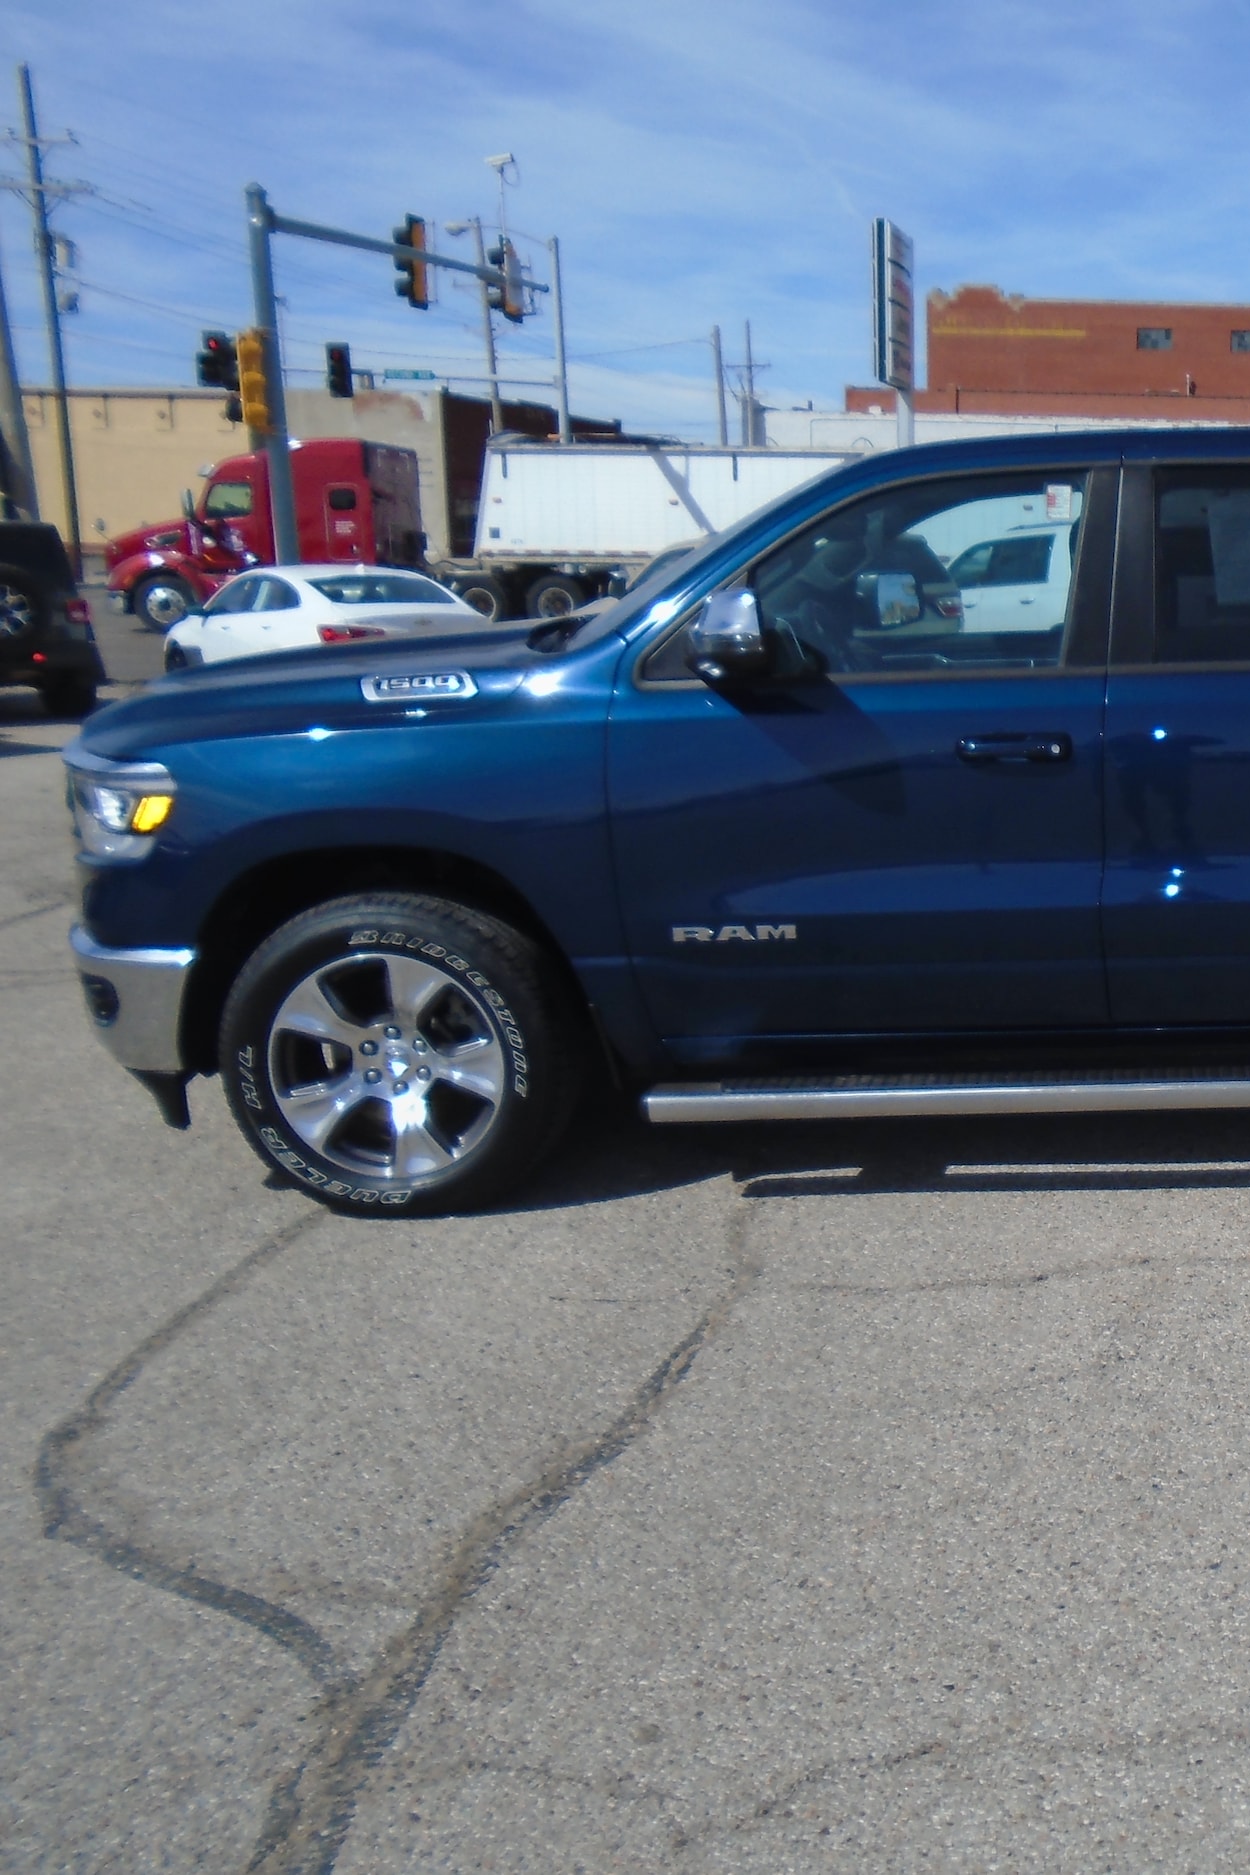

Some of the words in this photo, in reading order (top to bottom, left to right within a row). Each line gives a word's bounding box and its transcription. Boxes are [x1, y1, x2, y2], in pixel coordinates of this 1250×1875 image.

[380, 674, 460, 691] 1500
[672, 924, 798, 942] RAM
[348, 929, 530, 1098] BRIDGESTONE
[238, 1046, 263, 1110] H/L
[260, 1126, 413, 1205] DUELER
